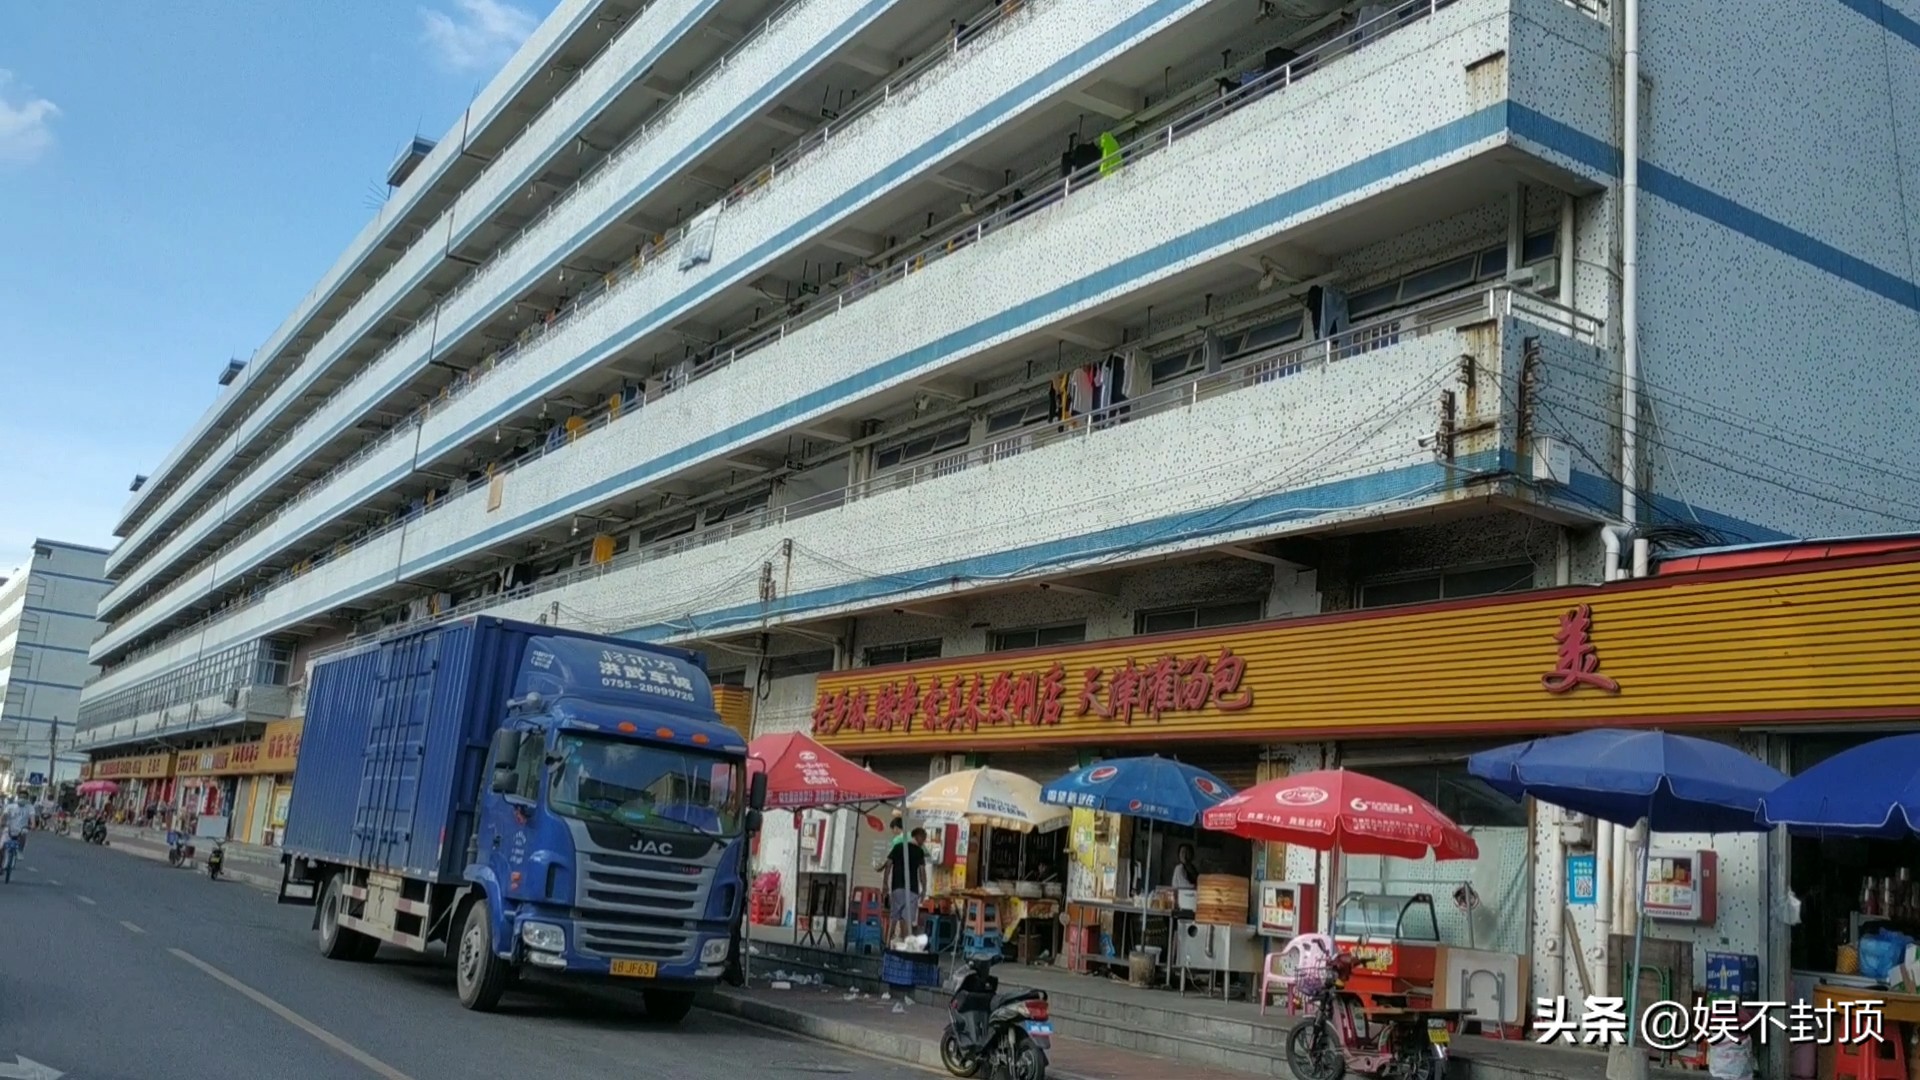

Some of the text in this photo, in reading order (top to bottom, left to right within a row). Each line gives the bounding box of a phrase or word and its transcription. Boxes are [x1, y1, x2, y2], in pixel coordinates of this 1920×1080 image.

[1075, 645, 1254, 725] 天津灌汤包
[1541, 602, 1620, 693] 美
[629, 839, 674, 855] JAC
